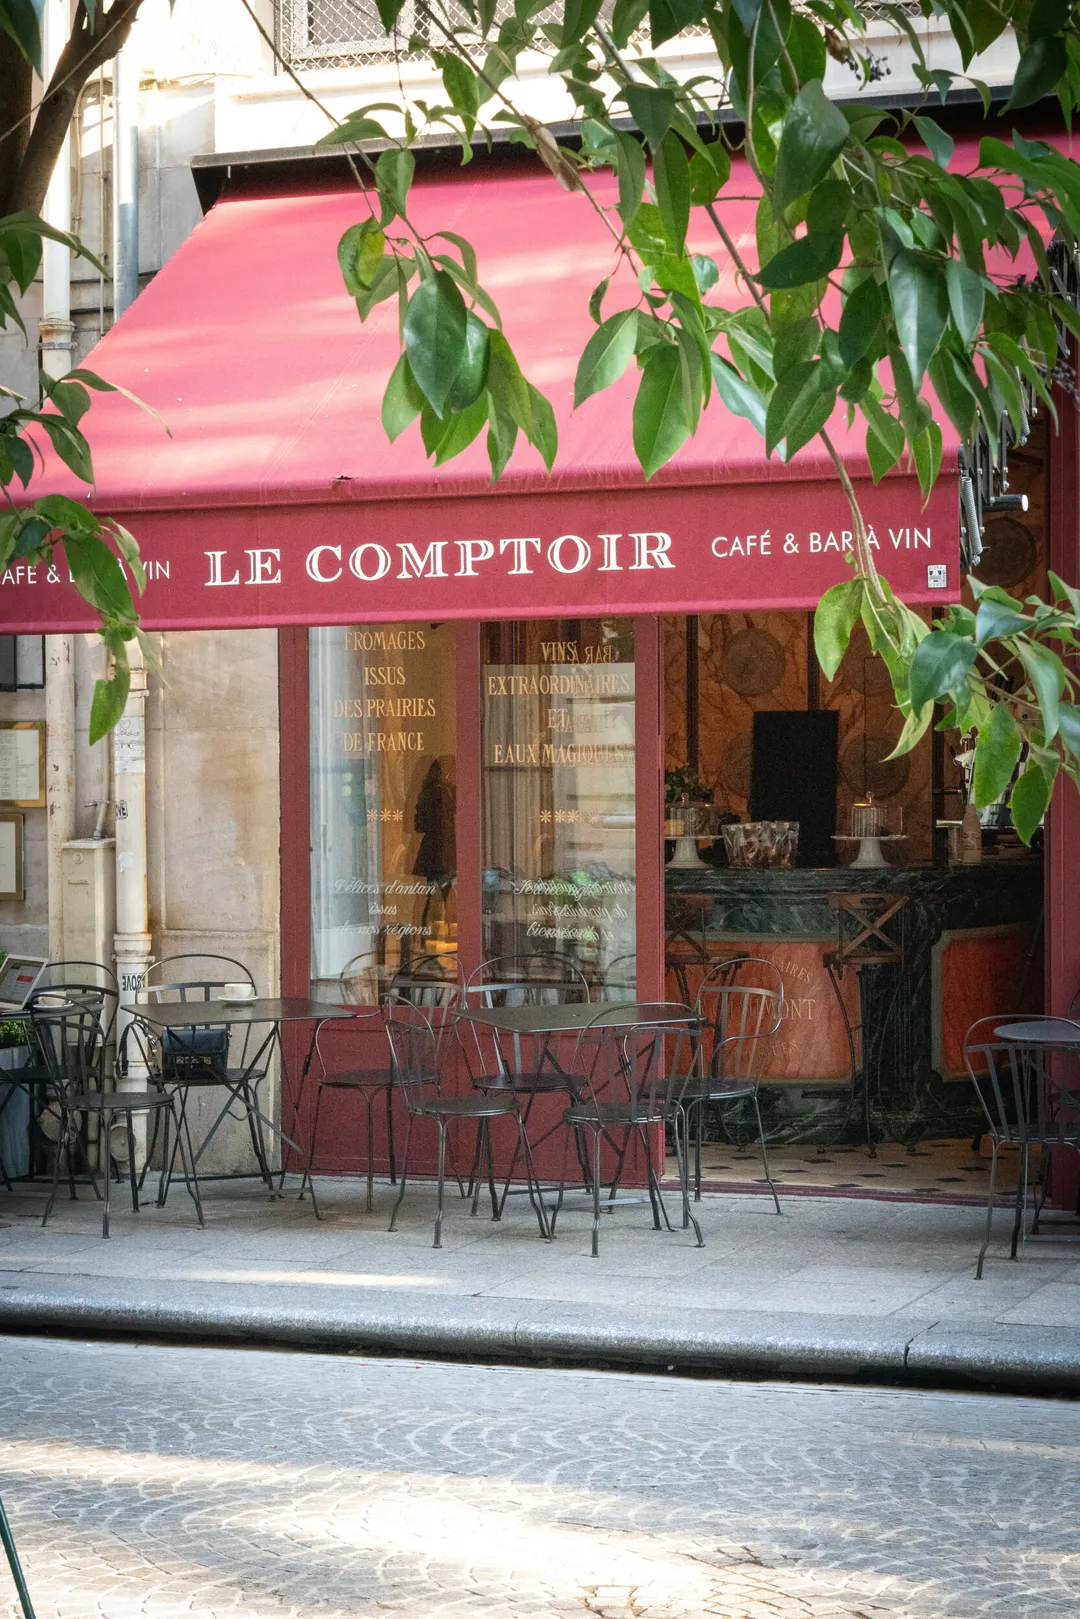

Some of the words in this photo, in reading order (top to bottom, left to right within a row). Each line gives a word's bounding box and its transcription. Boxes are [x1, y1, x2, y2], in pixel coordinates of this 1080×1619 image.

[711, 529, 772, 558] CAFÉ
[783, 532, 800, 555] &
[809, 531, 854, 553] BAR
[867, 524, 881, 550] À
[888, 527, 932, 549] VIN
[203, 548, 282, 586] LE
[305, 531, 676, 583] COMPTOIR
[46, 563, 61, 584] &
[344, 631, 426, 651] FROMAGES
[540, 640, 577, 663] VINS
[363, 666, 406, 686] ISSUS
[487, 673, 631, 696] EXTRAORDINAIRES
[334, 699, 363, 718] DES
[366, 698, 437, 718] PRAIRIES
[547, 708, 569, 729] ET
[343, 733, 363, 752] DE
[367, 732, 425, 751] FRANCE
[493, 744, 537, 764] EAUX
[368, 902, 398, 916] issus
[384, 923, 433, 941] régions
